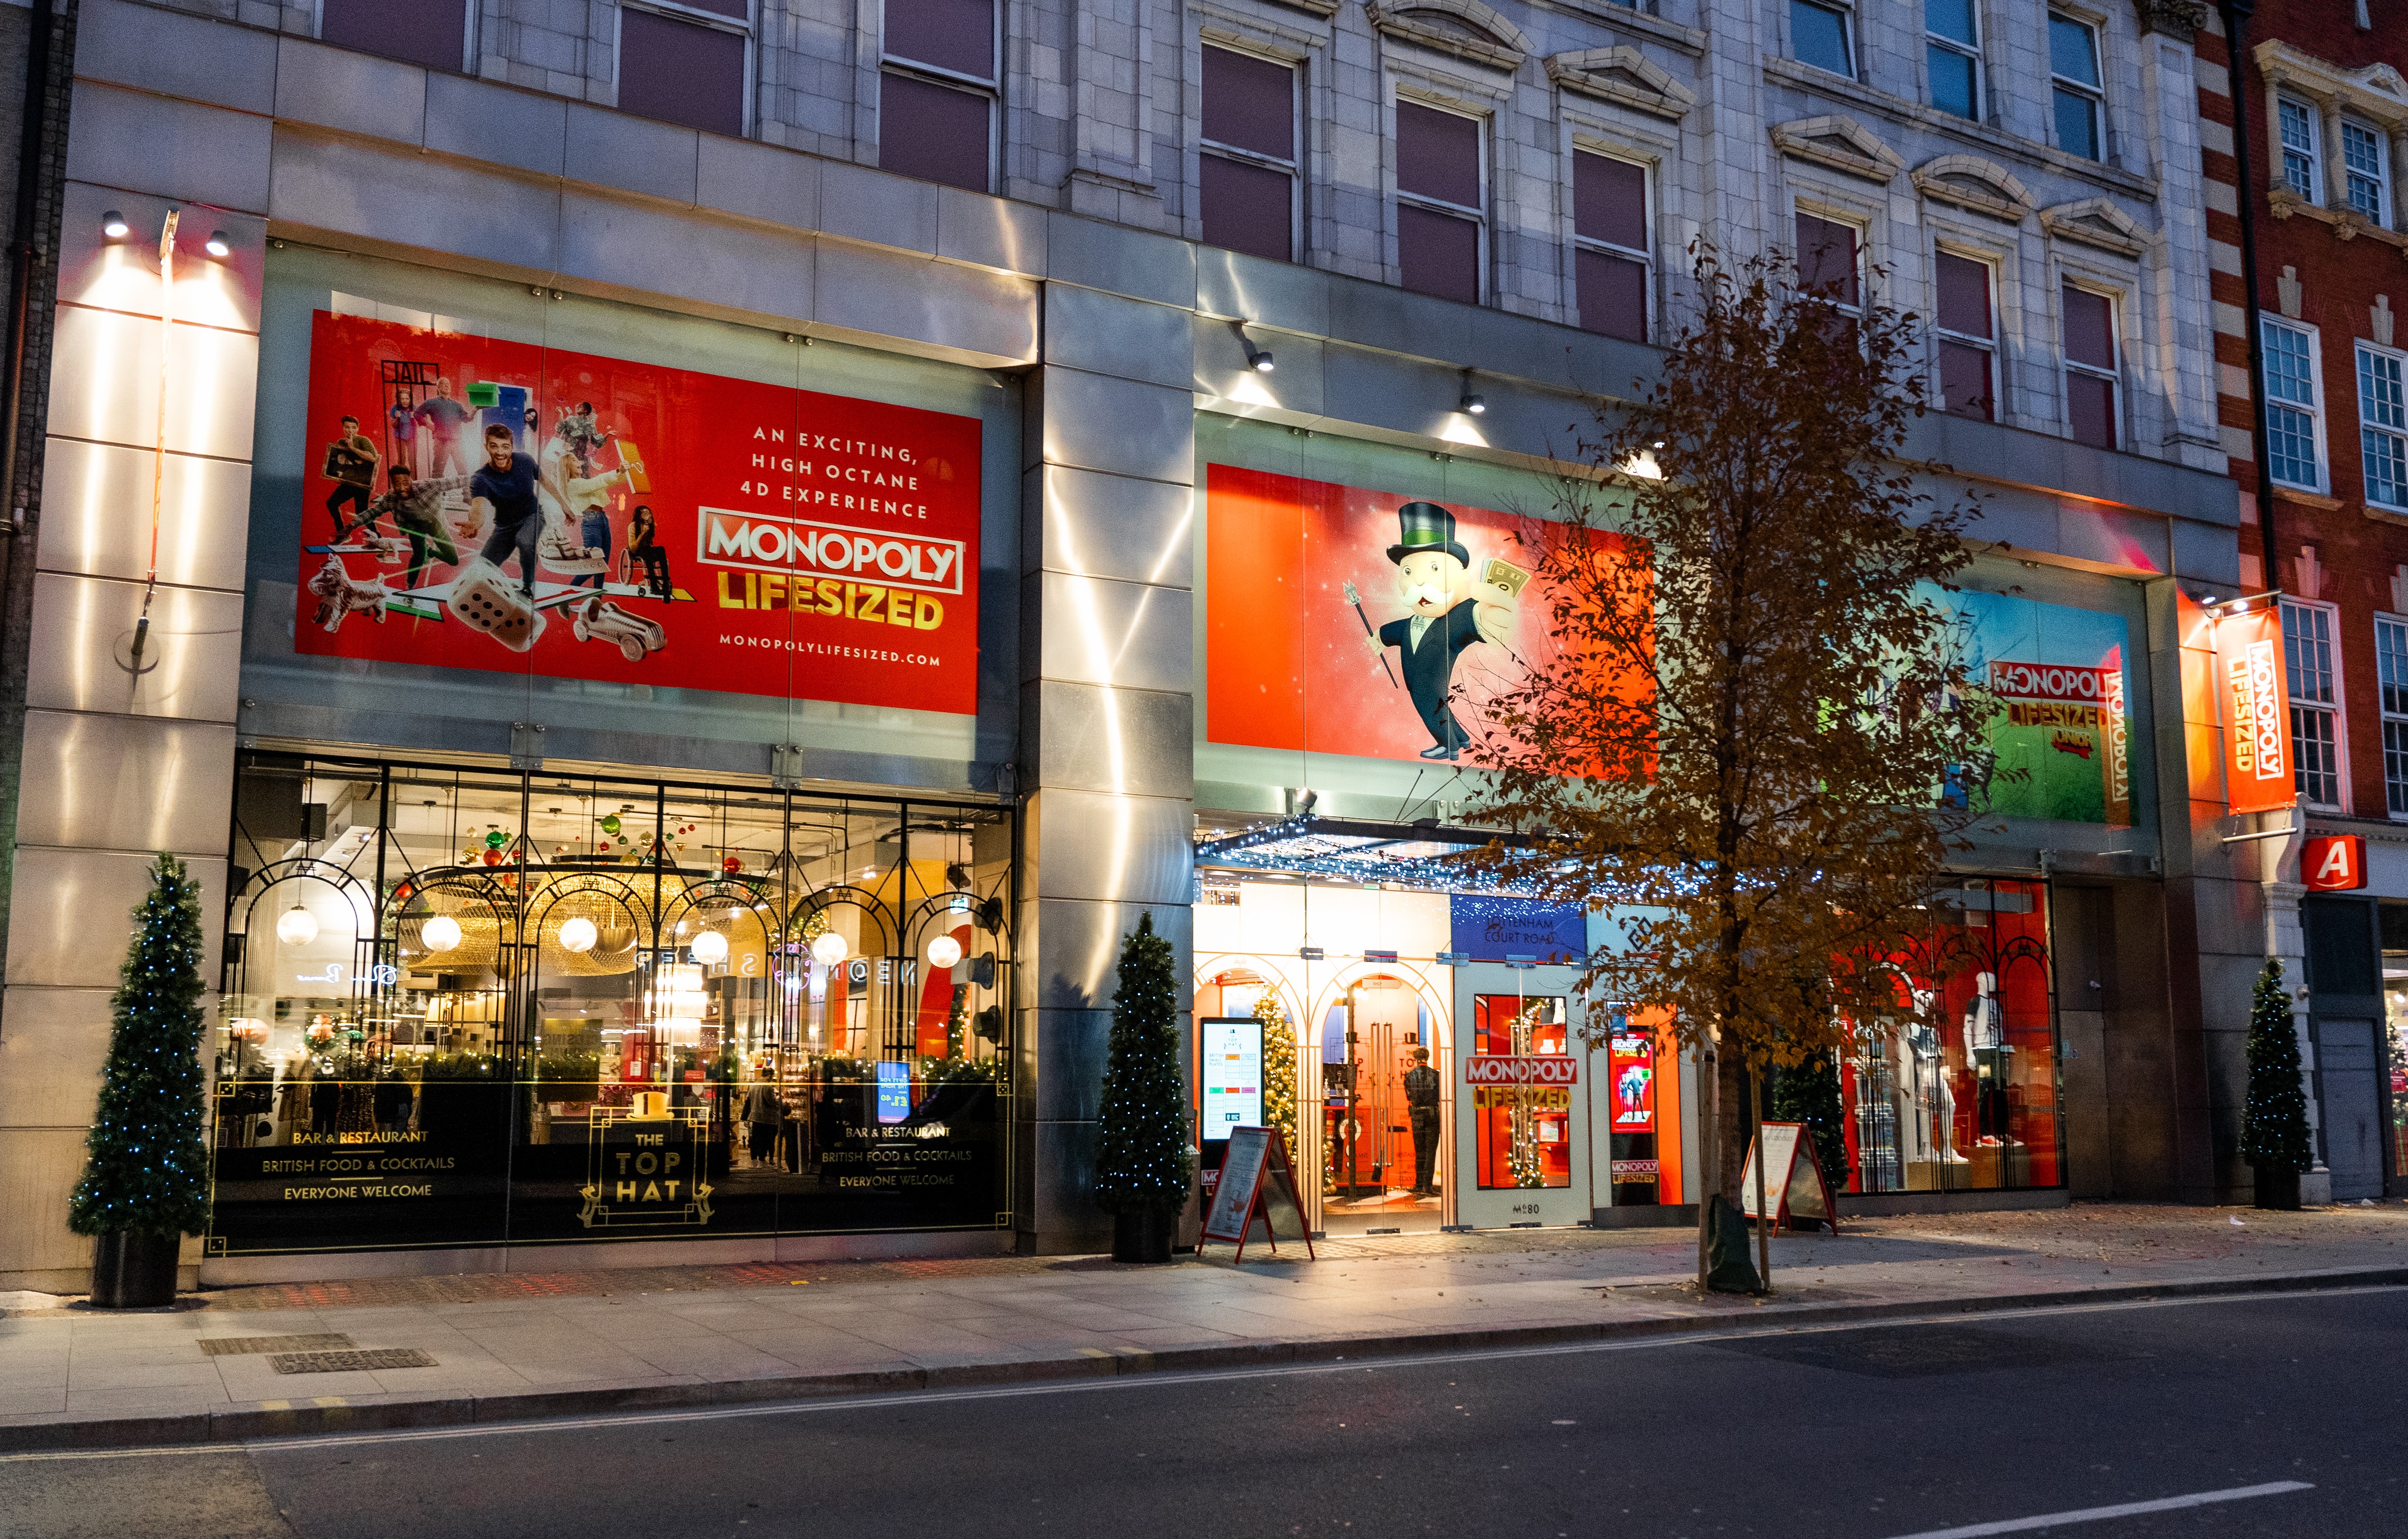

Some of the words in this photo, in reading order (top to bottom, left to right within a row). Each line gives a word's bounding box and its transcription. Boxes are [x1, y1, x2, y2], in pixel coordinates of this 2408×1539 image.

[392, 361, 431, 385] JAIL
[753, 426, 785, 444] AN
[799, 433, 917, 465] EXCITING,
[752, 454, 812, 475] HIGH
[826, 465, 917, 490] OCTANE
[741, 481, 768, 496] 4D
[783, 486, 927, 519] EXPERIENCE
[708, 516, 955, 582] MONOPOLY
[717, 571, 944, 630] LIFESIZED
[719, 634, 940, 666] MONOPOLYLIFESIZED.COM
[2227, 656, 2254, 772] LIFESIZED
[2251, 647, 2280, 774] MONOPOLY
[2317, 841, 2349, 879] A
[1485, 931, 1519, 944] COURT
[1399, 1058, 1414, 1067] TO
[1468, 1060, 1576, 1081] MONOPOLY
[1473, 1088, 1572, 1110] LIFESIZED
[293, 1132, 324, 1145] BAR
[326, 1134, 335, 1144] &
[339, 1131, 428, 1145] RESTAURANT
[636, 1134, 664, 1148] THE
[846, 1127, 868, 1137] BAR
[872, 1129, 879, 1137] &
[882, 1127, 951, 1138] RESTAURANT
[262, 1160, 314, 1173] BRITISH
[320, 1159, 362, 1172] FOOD
[367, 1160, 375, 1171] &
[380, 1157, 455, 1170] COCKTAILS
[616, 1152, 681, 1175] TOP
[822, 1151, 863, 1163] BRITISH
[866, 1151, 900, 1162] FOOD
[904, 1153, 910, 1161] &
[914, 1150, 972, 1161] COCKTAILS
[1612, 1162, 1657, 1172] MONOPOLY
[839, 1175, 897, 1187] EVERYONE
[899, 1174, 954, 1185] WELCOME
[1613, 1173, 1655, 1184] LIFESIZED
[284, 1186, 358, 1200] EVERYONE
[361, 1184, 432, 1198] WELCOME
[616, 1180, 681, 1203] HAT
